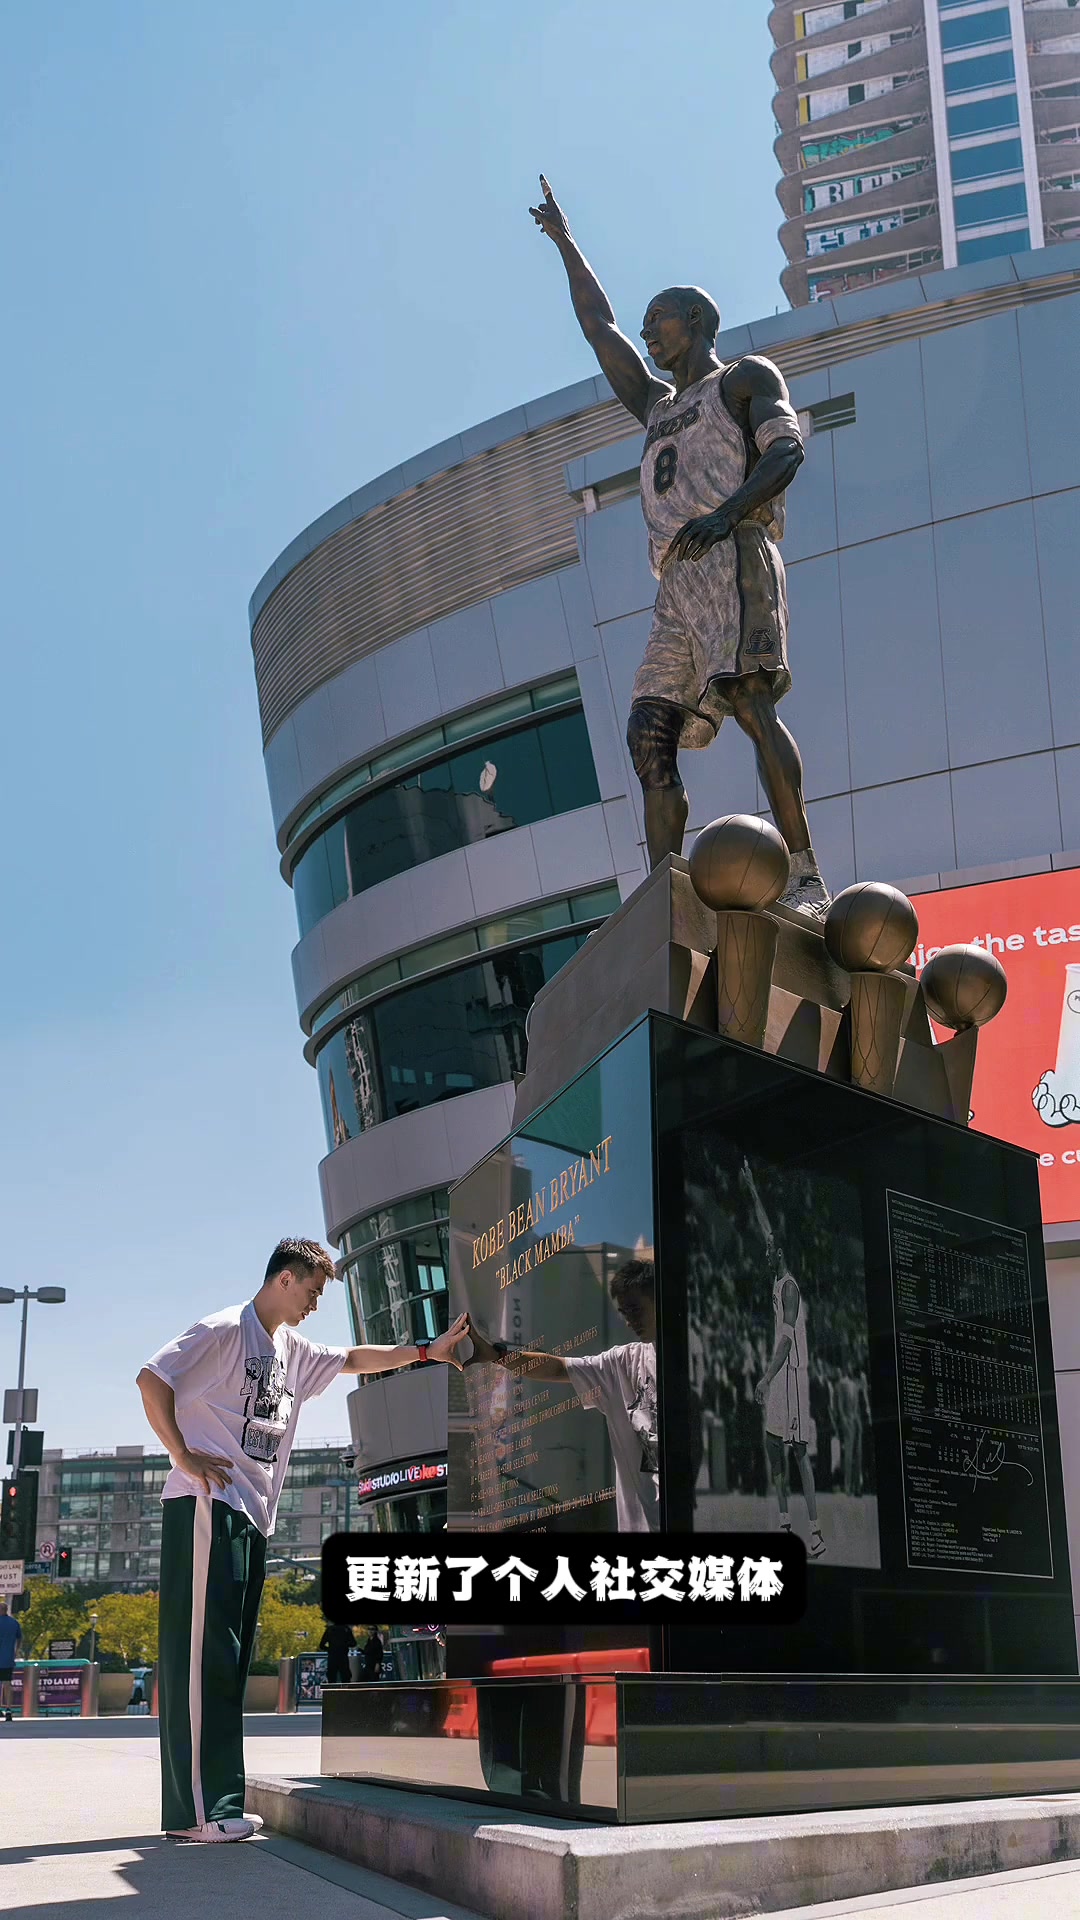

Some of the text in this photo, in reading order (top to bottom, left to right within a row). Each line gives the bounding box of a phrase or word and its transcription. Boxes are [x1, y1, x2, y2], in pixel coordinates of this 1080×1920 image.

[653, 444, 678, 496] 8
[472, 1135, 613, 1270] KOBE BEAN BRYANT
[371, 1472, 400, 1490] STUDIO
[64, 1677, 80, 1685] LIVE
